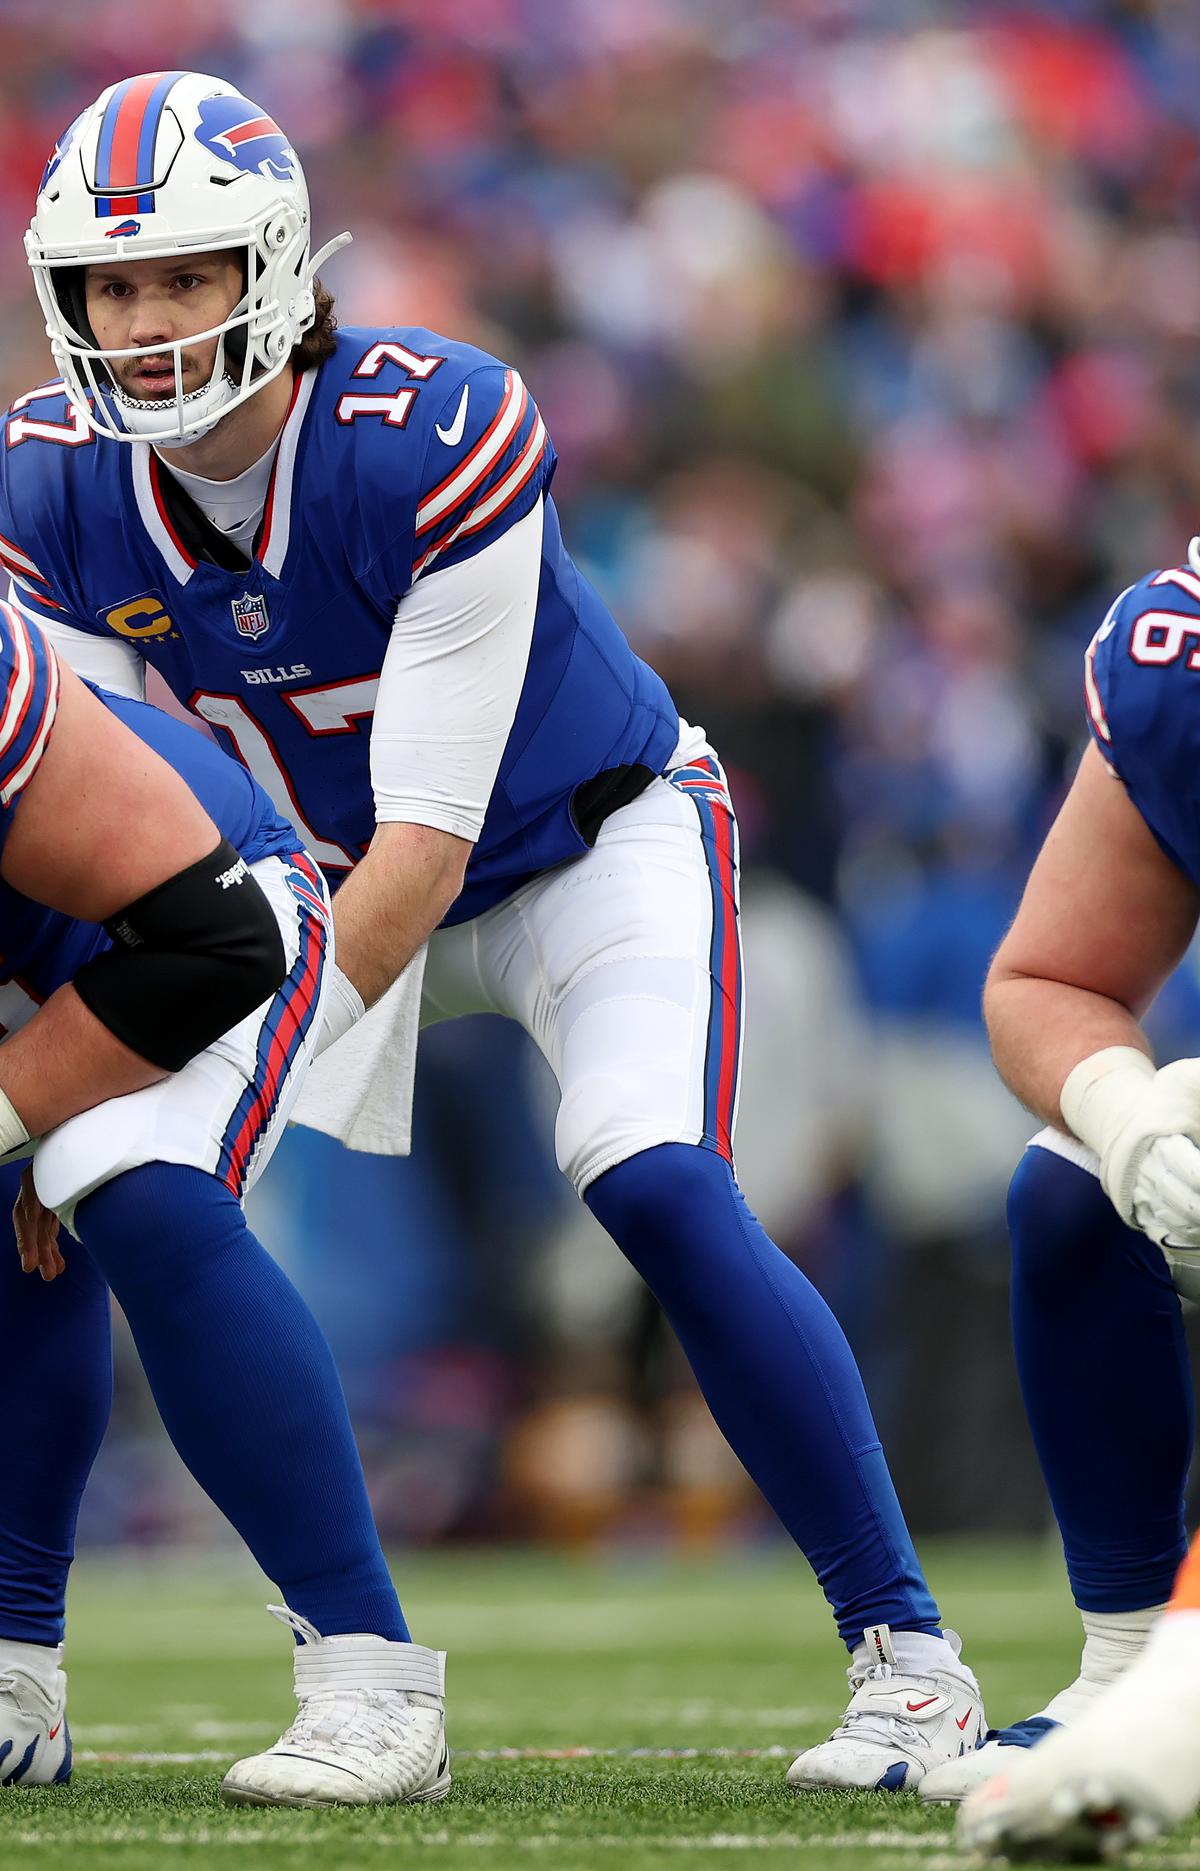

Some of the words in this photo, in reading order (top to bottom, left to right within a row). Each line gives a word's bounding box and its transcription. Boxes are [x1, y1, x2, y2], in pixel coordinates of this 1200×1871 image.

[334, 341, 447, 430] 17
[106, 597, 171, 637] C
[239, 613, 264, 631] NFL
[240, 664, 311, 684] BILLS
